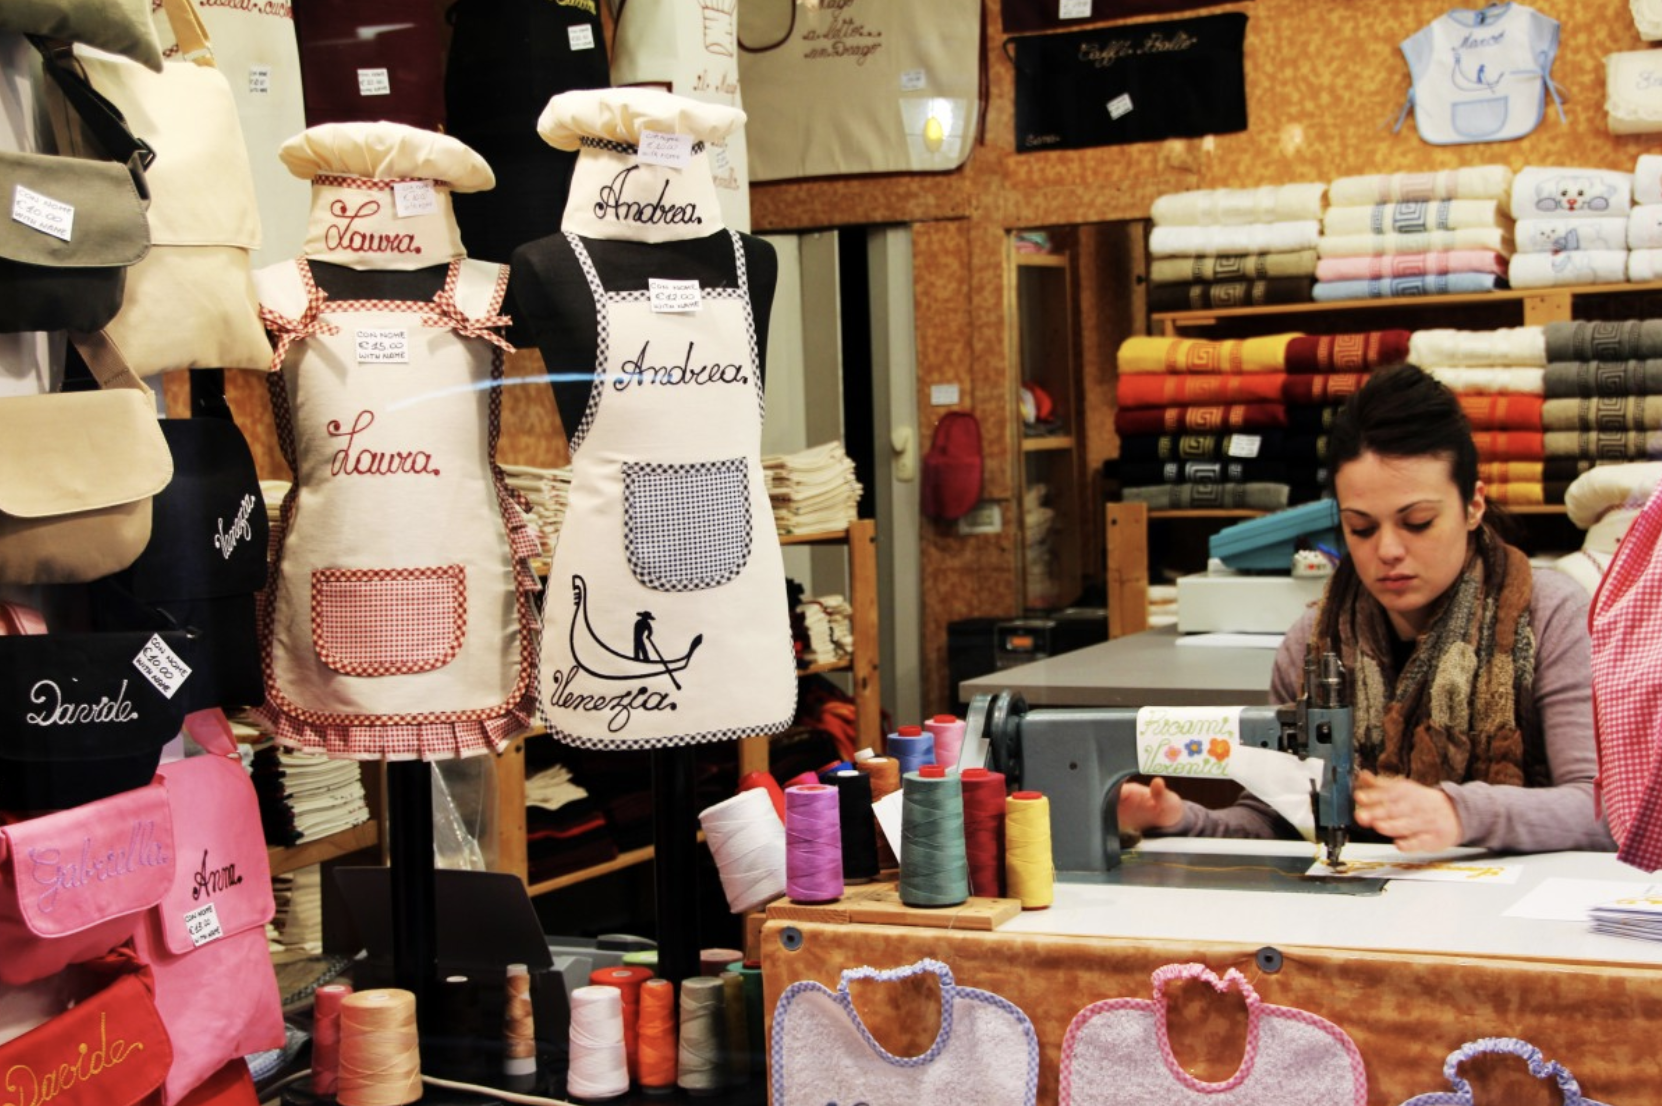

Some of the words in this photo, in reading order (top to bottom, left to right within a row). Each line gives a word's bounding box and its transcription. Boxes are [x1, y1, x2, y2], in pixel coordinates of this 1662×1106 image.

[18, 188, 39, 203] CON
[43, 200, 73, 215] NOME
[14, 209, 38, 226] WITH
[39, 221, 67, 237] NAME
[650, 282, 670, 290] CON
[672, 283, 698, 291] NOME
[357, 330, 378, 339] CON
[379, 331, 406, 340] NOME
[358, 352, 381, 360] WITH
[136, 657, 154, 676] WITH
[151, 637, 166, 655] CON
[165, 654, 188, 678] NOME
